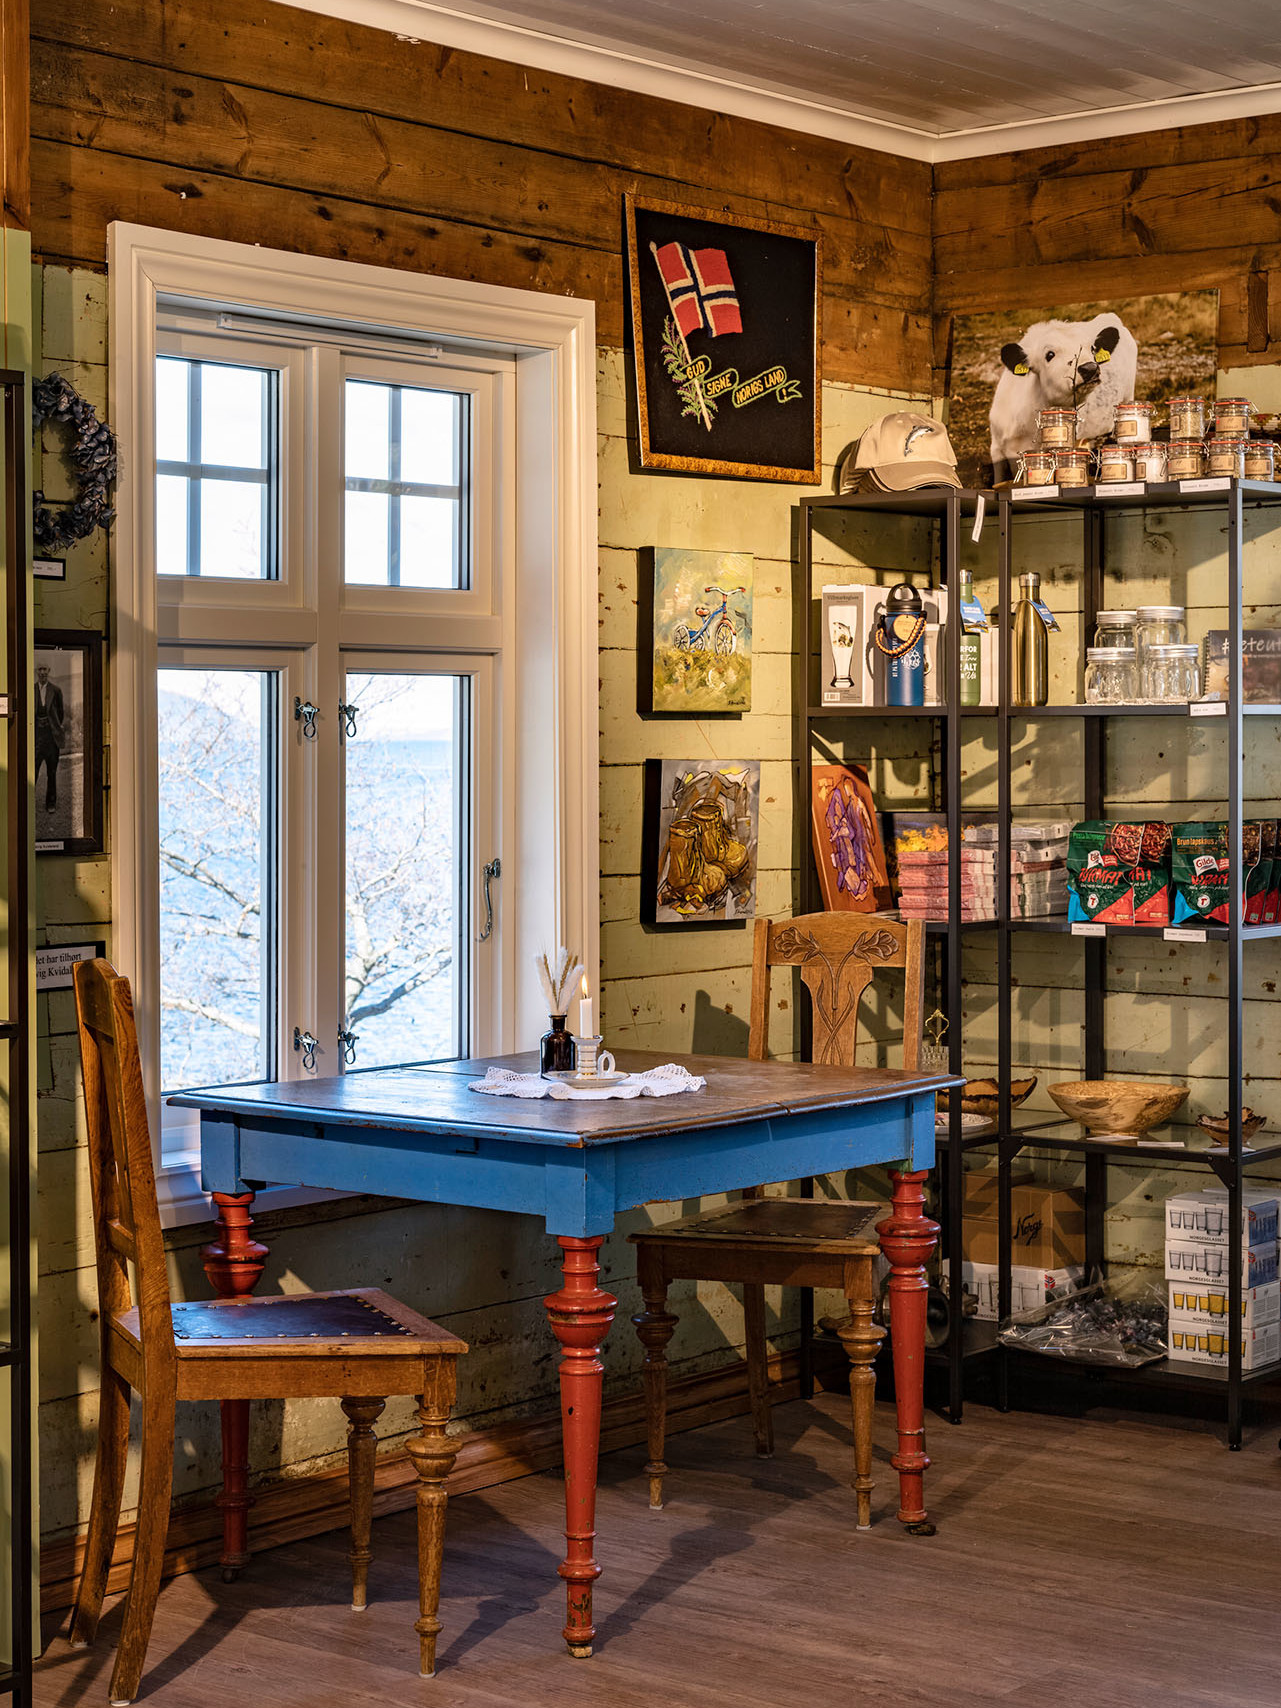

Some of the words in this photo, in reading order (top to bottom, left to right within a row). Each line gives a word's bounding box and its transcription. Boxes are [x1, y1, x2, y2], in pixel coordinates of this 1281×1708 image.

[686, 361, 706, 380] GUD
[706, 373, 733, 396] SIGNE
[764, 369, 785, 389] LAND
[963, 663, 978, 672] ALT
[1195, 857, 1214, 868] Gilde
[48, 965, 72, 976] Kvidal
